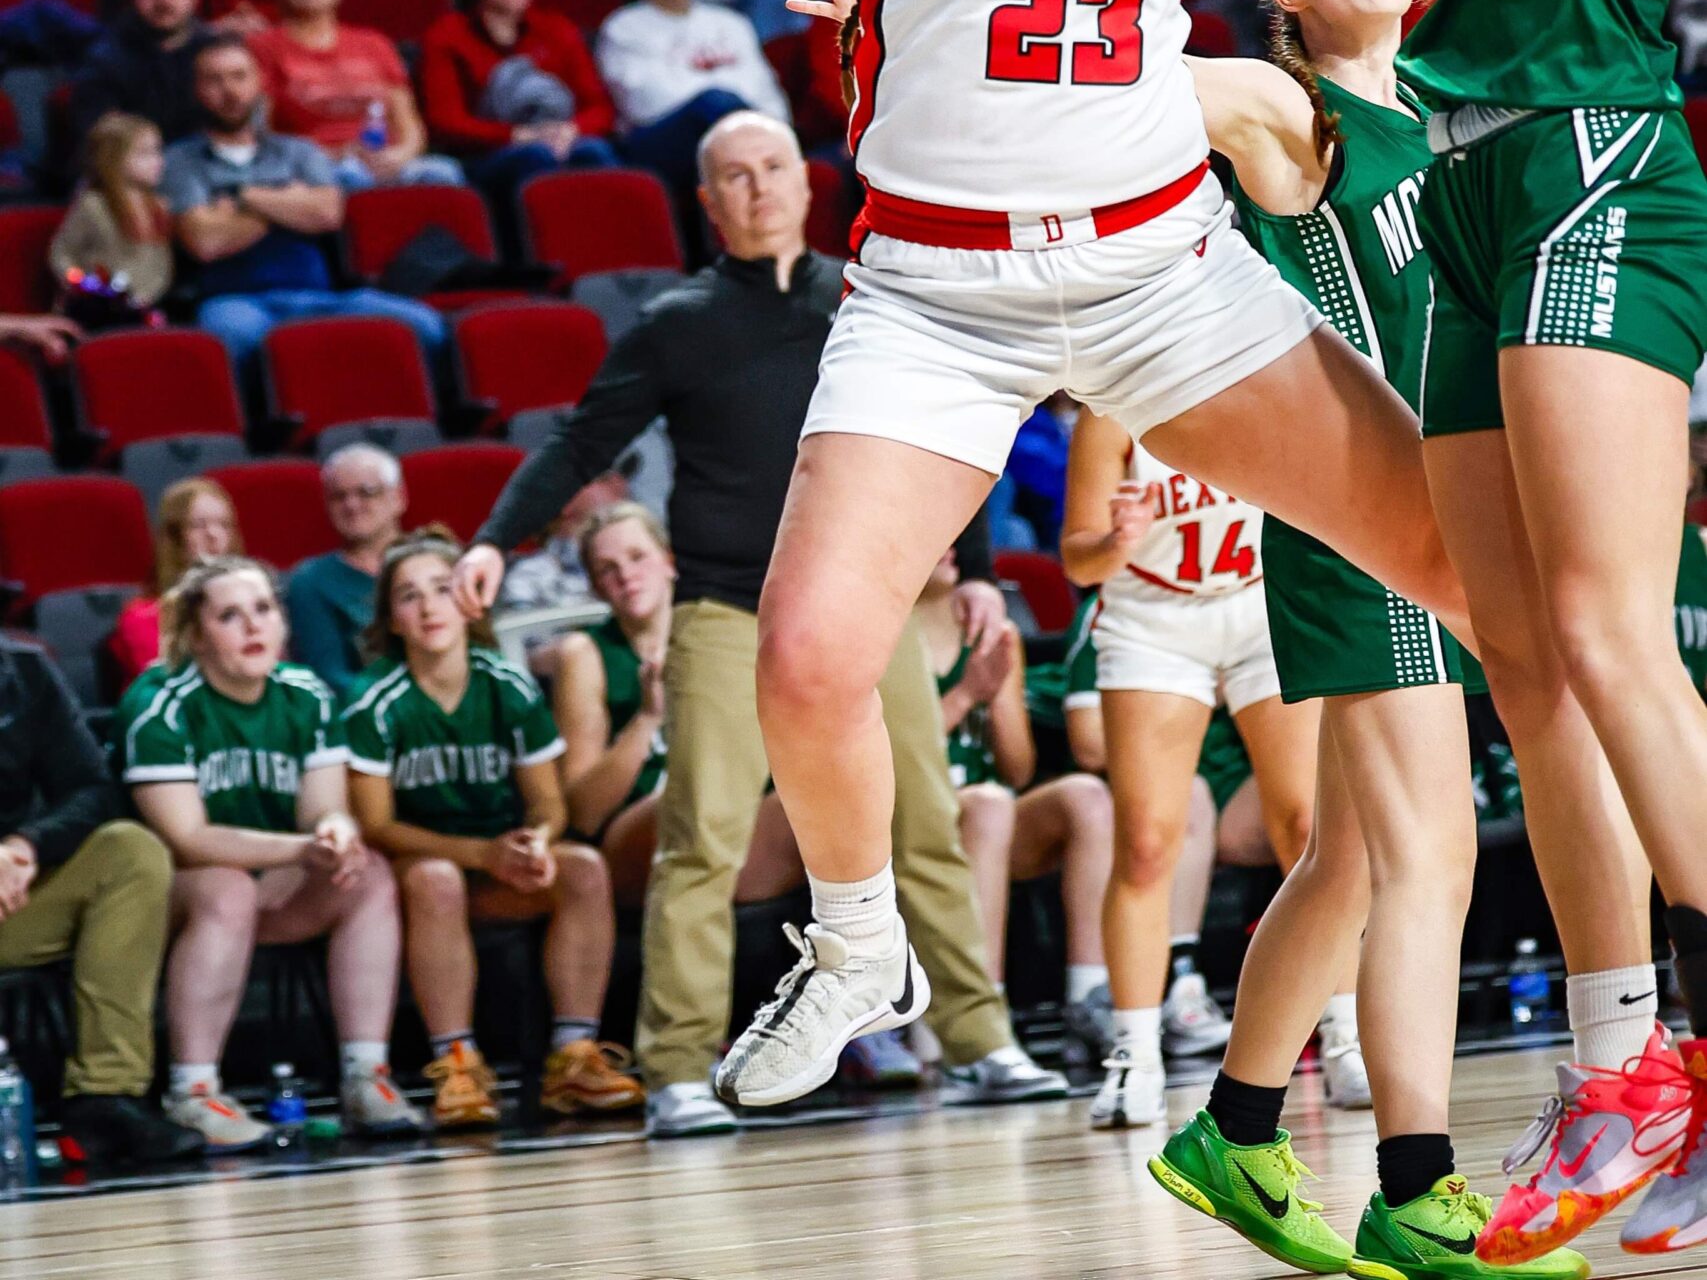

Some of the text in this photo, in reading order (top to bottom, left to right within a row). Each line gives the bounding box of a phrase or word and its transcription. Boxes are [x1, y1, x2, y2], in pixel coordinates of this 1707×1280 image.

[1040, 214, 1064, 243] D
[1371, 167, 1429, 276] MO
[1590, 206, 1627, 339] MUSTANGS
[1175, 520, 1256, 582] 14
